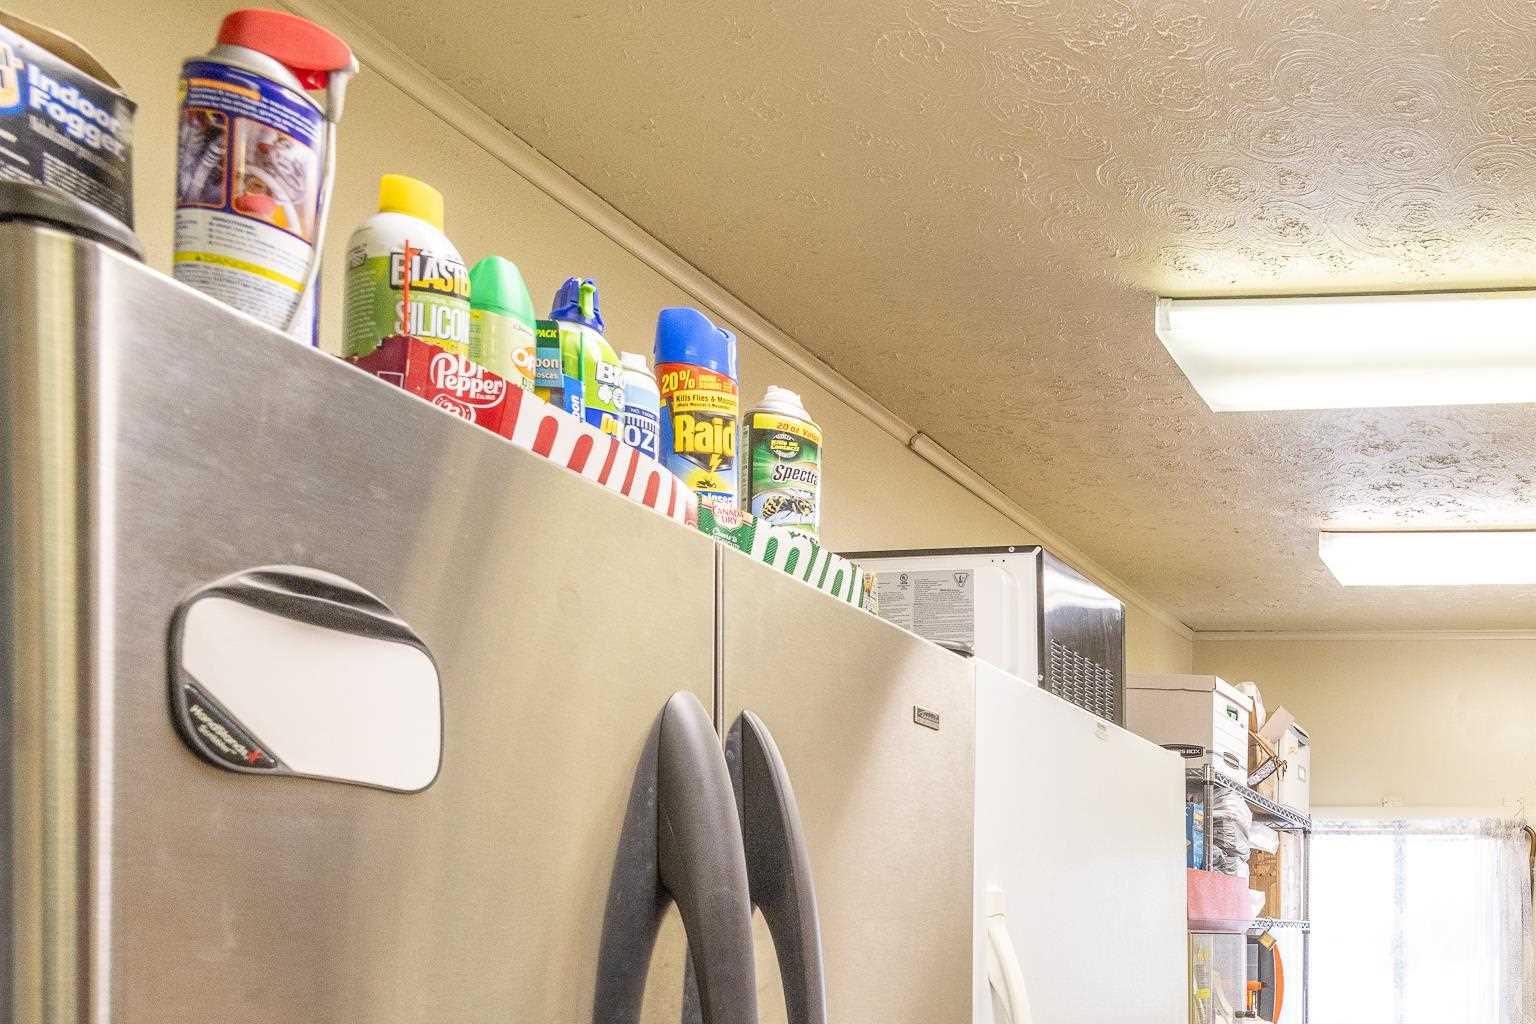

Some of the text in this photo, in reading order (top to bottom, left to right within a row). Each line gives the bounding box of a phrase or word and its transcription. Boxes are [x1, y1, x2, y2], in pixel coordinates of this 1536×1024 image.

[28, 63, 123, 137] Indoor
[28, 86, 127, 162] Fogger
[430, 352, 503, 399] Pepper
[661, 369, 695, 396] 20%
[676, 394, 691, 402] Kills
[692, 394, 708, 402] Flies
[674, 414, 736, 456] Raid
